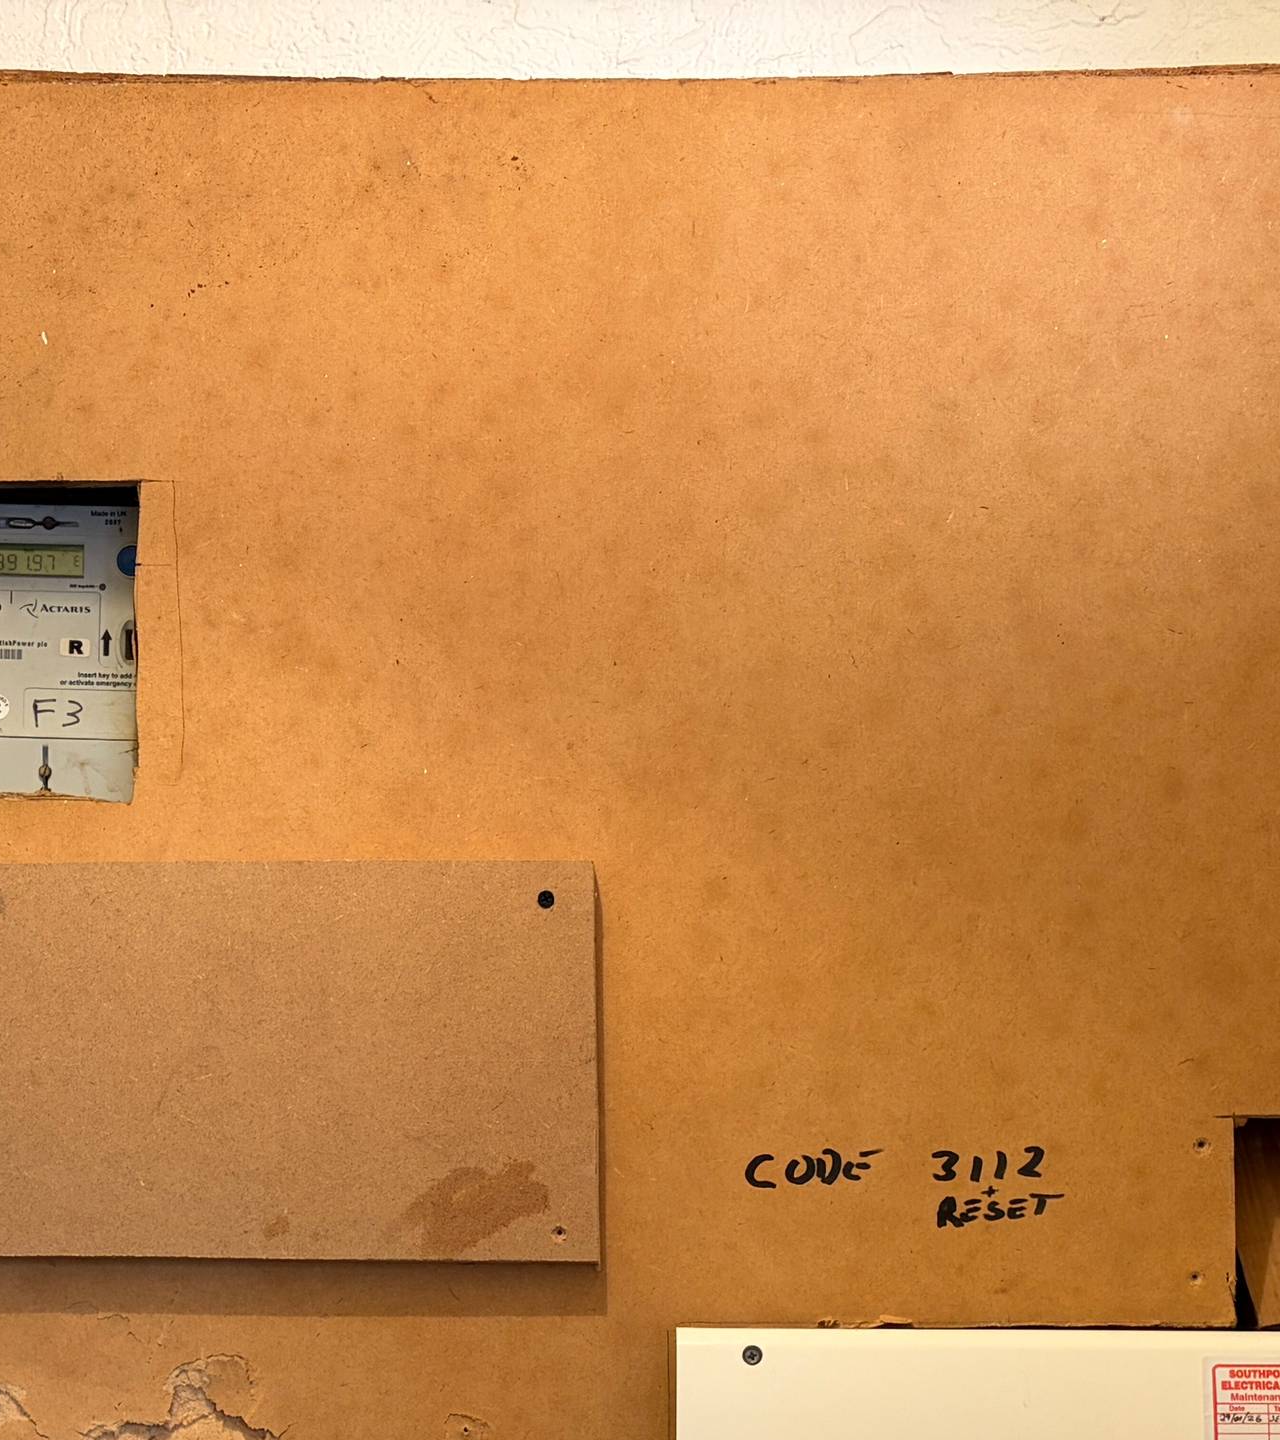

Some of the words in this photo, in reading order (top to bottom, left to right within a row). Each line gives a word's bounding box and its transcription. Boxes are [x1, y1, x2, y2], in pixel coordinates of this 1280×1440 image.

[68, 639, 84, 655] R
[98, 672, 110, 680] key
[745, 1148, 885, 1189] CODE
[931, 1146, 1046, 1183] 3112
[936, 1192, 1065, 1228] RESET
